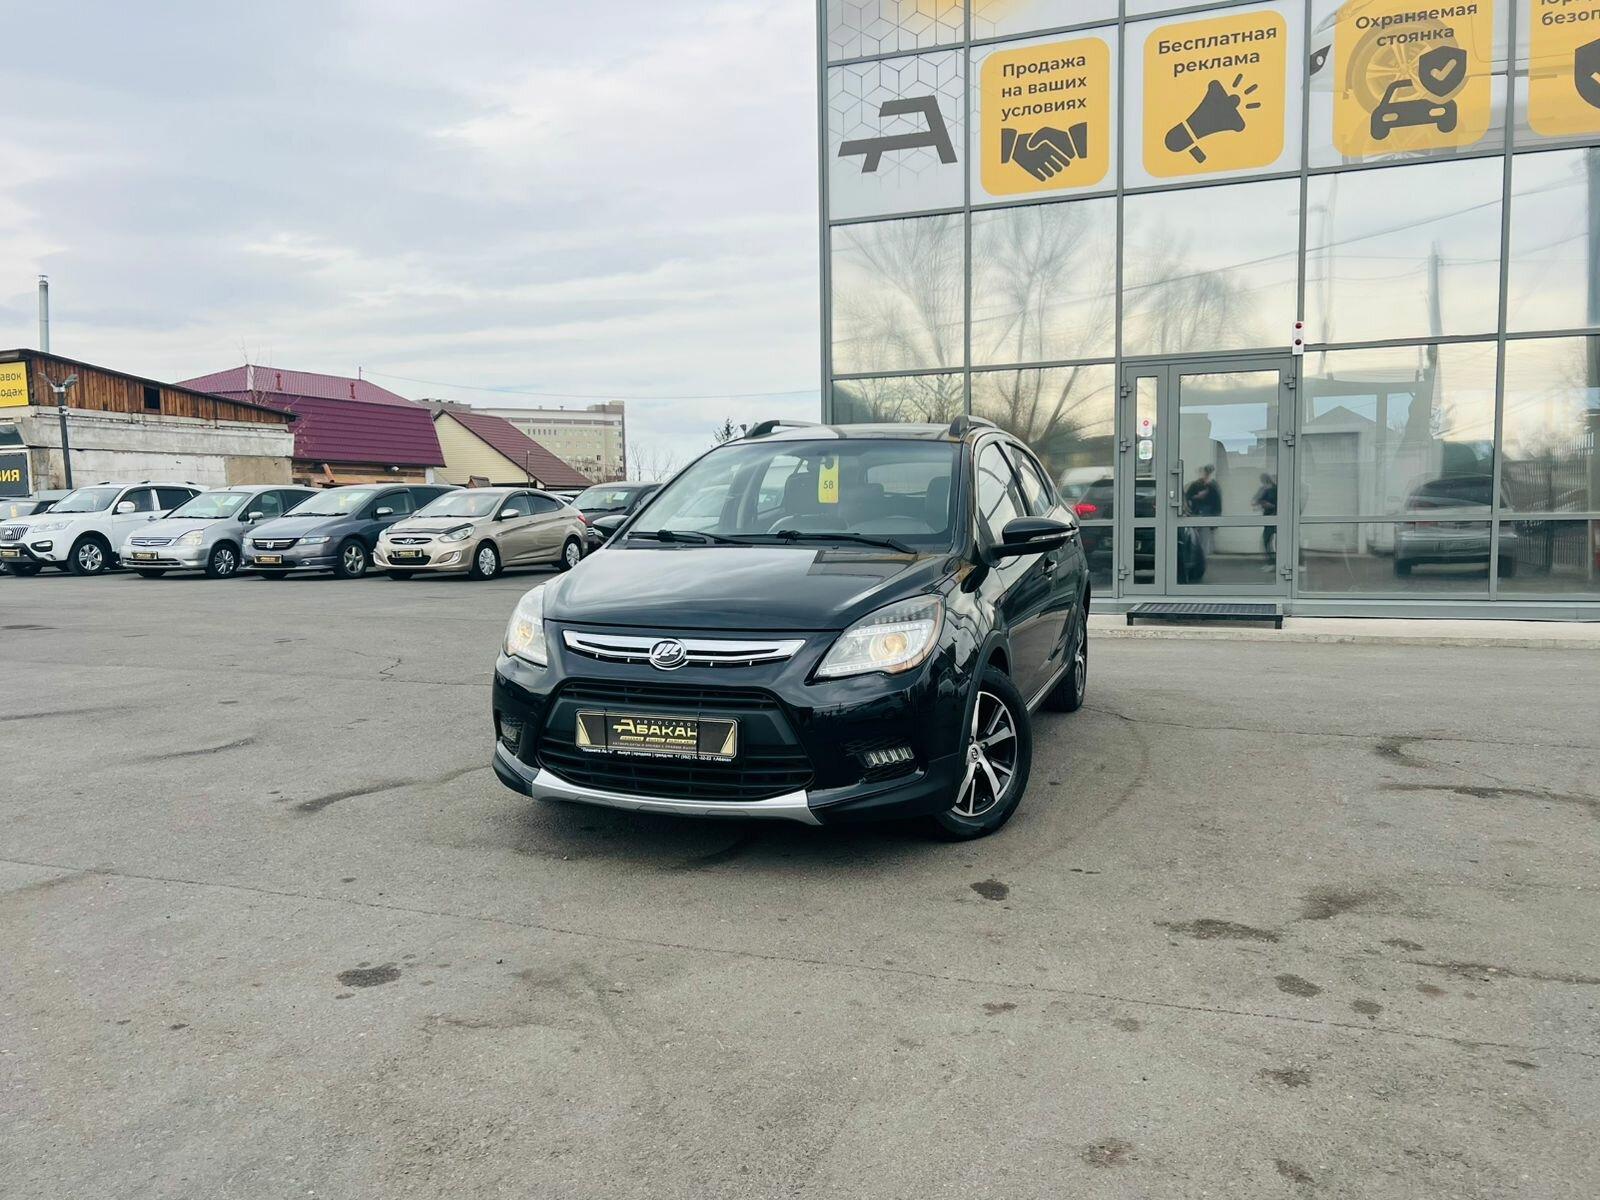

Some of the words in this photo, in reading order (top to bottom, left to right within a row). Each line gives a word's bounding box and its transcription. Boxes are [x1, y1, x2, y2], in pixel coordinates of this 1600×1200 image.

[1356, 4, 1478, 29] Охраняемая
[1158, 27, 1277, 55] Бесплатная
[1376, 27, 1455, 47] стоянка
[1003, 56, 1086, 78] Продажа
[1173, 51, 1260, 77] реклама
[1002, 86, 1022, 98] на
[1028, 76, 1087, 94] ваших
[1001, 97, 1087, 122] условиях
[0, 469, 20, 482] ИЯ
[823, 480, 834, 490] 58
